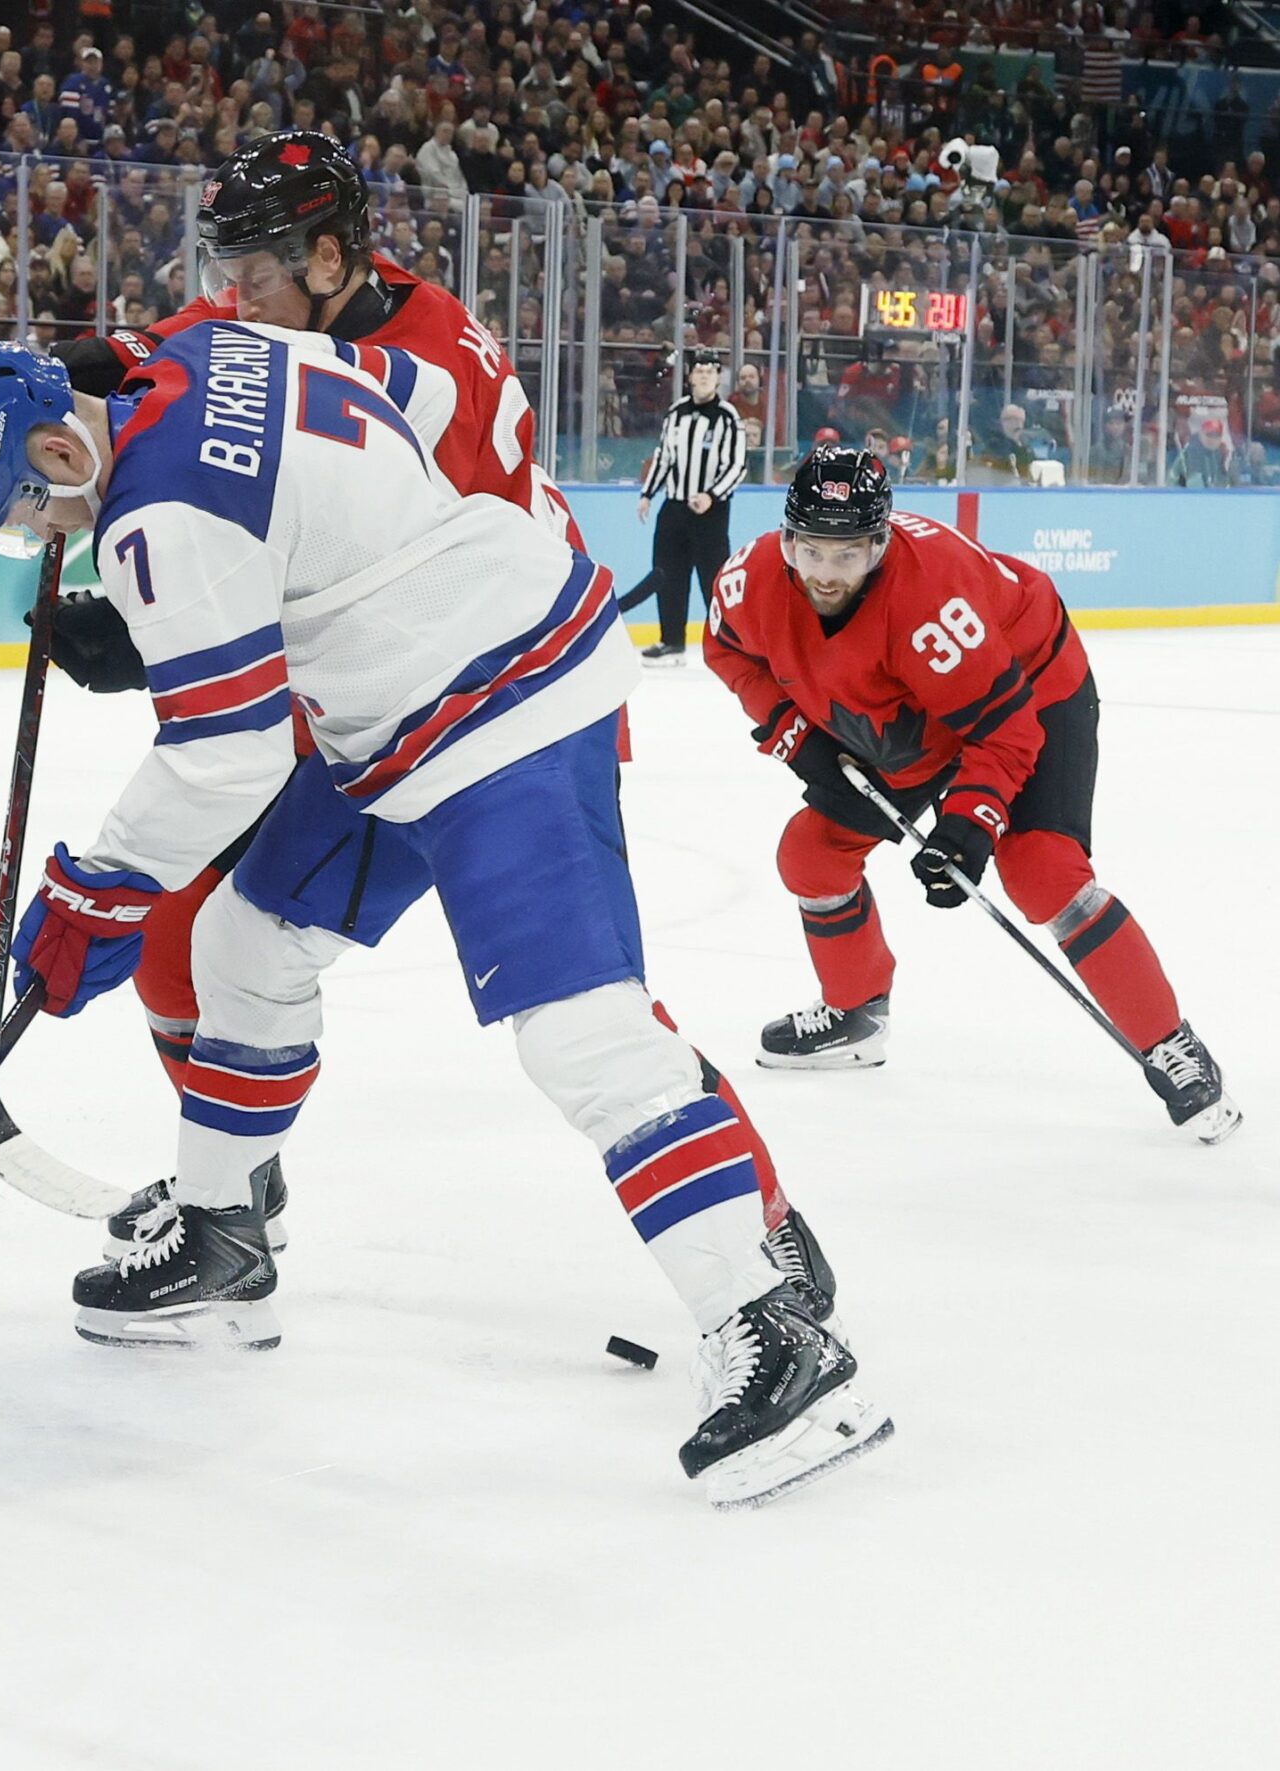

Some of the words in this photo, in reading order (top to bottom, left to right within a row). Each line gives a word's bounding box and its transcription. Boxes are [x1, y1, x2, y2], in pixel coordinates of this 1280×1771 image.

[296, 193, 335, 214] CCM
[296, 362, 432, 484] 7
[821, 481, 850, 500] 38
[1033, 529, 1093, 549] OLYMPIC
[114, 527, 156, 605] 7
[911, 597, 986, 675] 38
[772, 714, 808, 762] CM
[39, 868, 153, 923] TRUE
